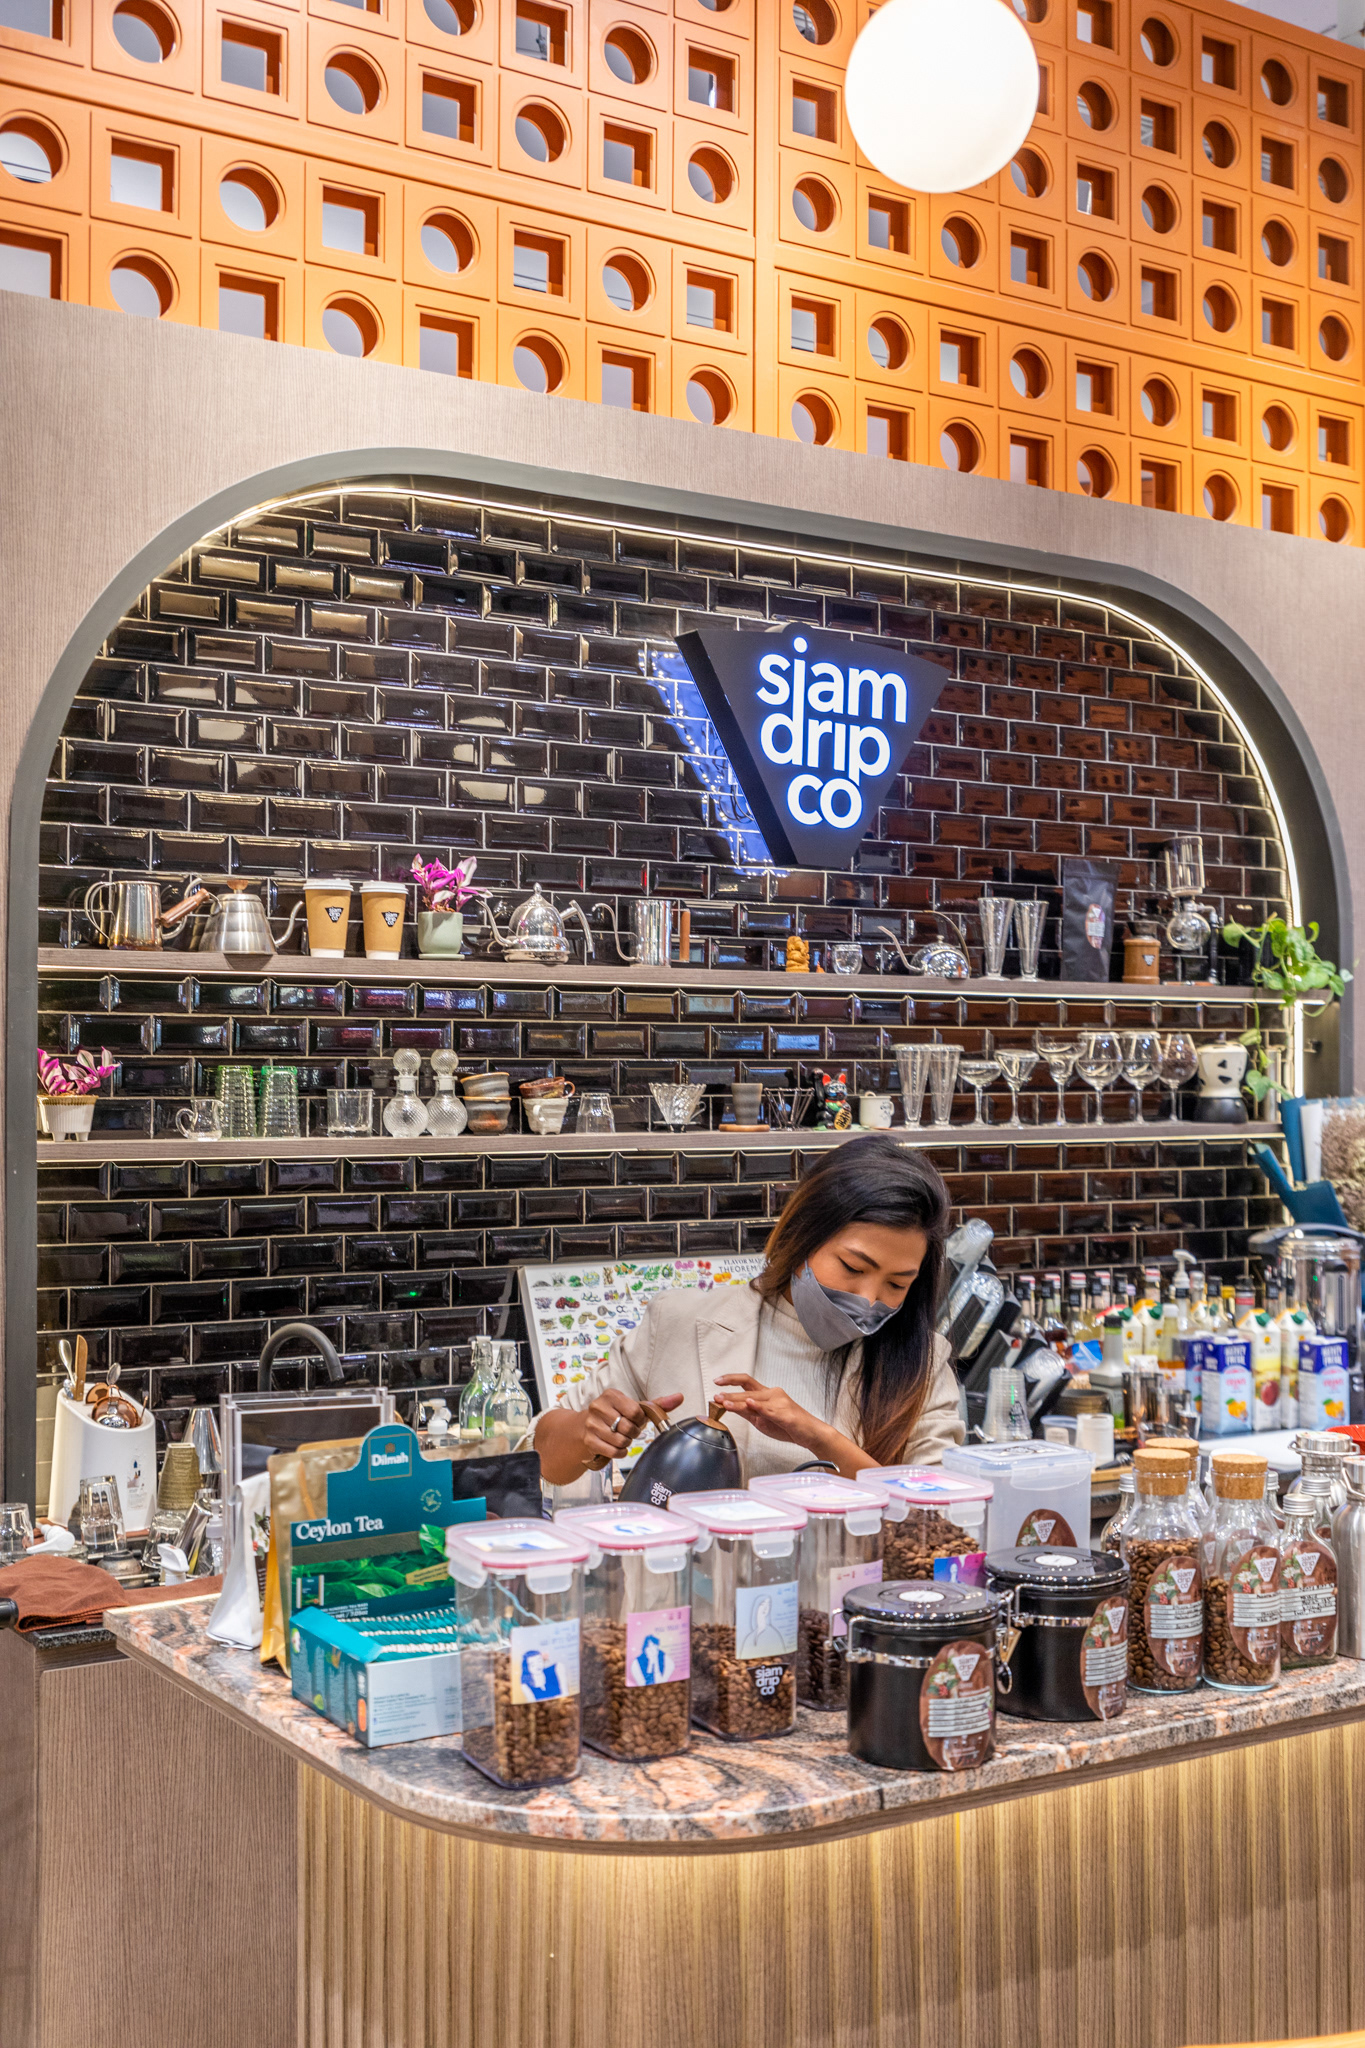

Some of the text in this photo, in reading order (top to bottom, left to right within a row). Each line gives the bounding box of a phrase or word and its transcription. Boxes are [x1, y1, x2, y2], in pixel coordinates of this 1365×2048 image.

[757, 637, 908, 723] siam
[761, 712, 891, 786] drip
[787, 774, 863, 829] co
[719, 1265, 758, 1273] THEOREM
[723, 1258, 748, 1266] FLAVOR
[371, 1452, 409, 1467] Dilmah
[650, 1488, 667, 1502] drip
[652, 1482, 672, 1498] siam
[650, 1496, 661, 1506] co
[295, 1515, 384, 1542] Ceylon Tea
[755, 1665, 784, 1679] siam
[755, 1675, 780, 1688] drip
[760, 1685, 776, 1696] co
